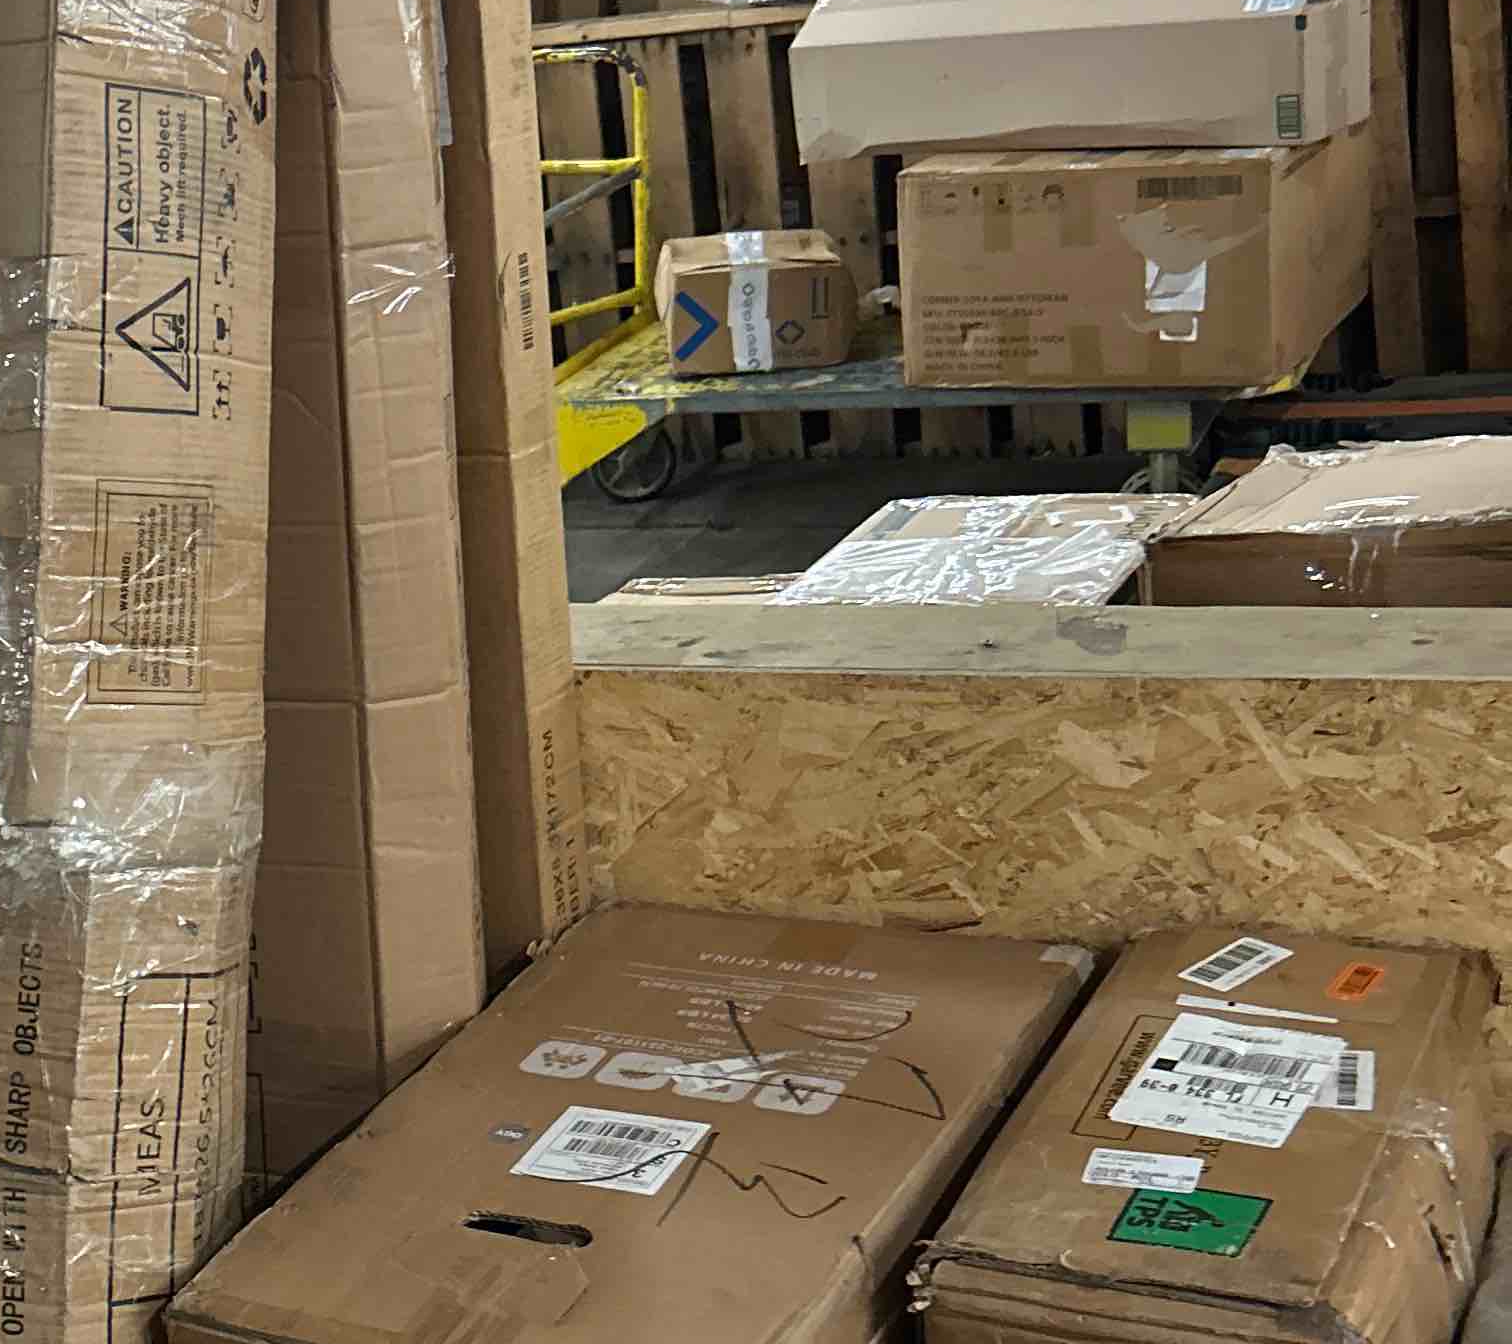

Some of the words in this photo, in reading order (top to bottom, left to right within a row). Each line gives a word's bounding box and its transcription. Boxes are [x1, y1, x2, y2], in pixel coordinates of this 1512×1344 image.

[117, 97, 133, 213] CAUTION
[157, 104, 171, 172] object.
[155, 179, 173, 242] Heavy
[696, 951, 769, 966] CHINA
[814, 965, 878, 978] MADE
[13, 941, 43, 1057] OBJECTS
[6, 1071, 32, 1155] SHARP
[1127, 1196, 1168, 1229] TPS
[0, 1268, 25, 1336] OPEN
